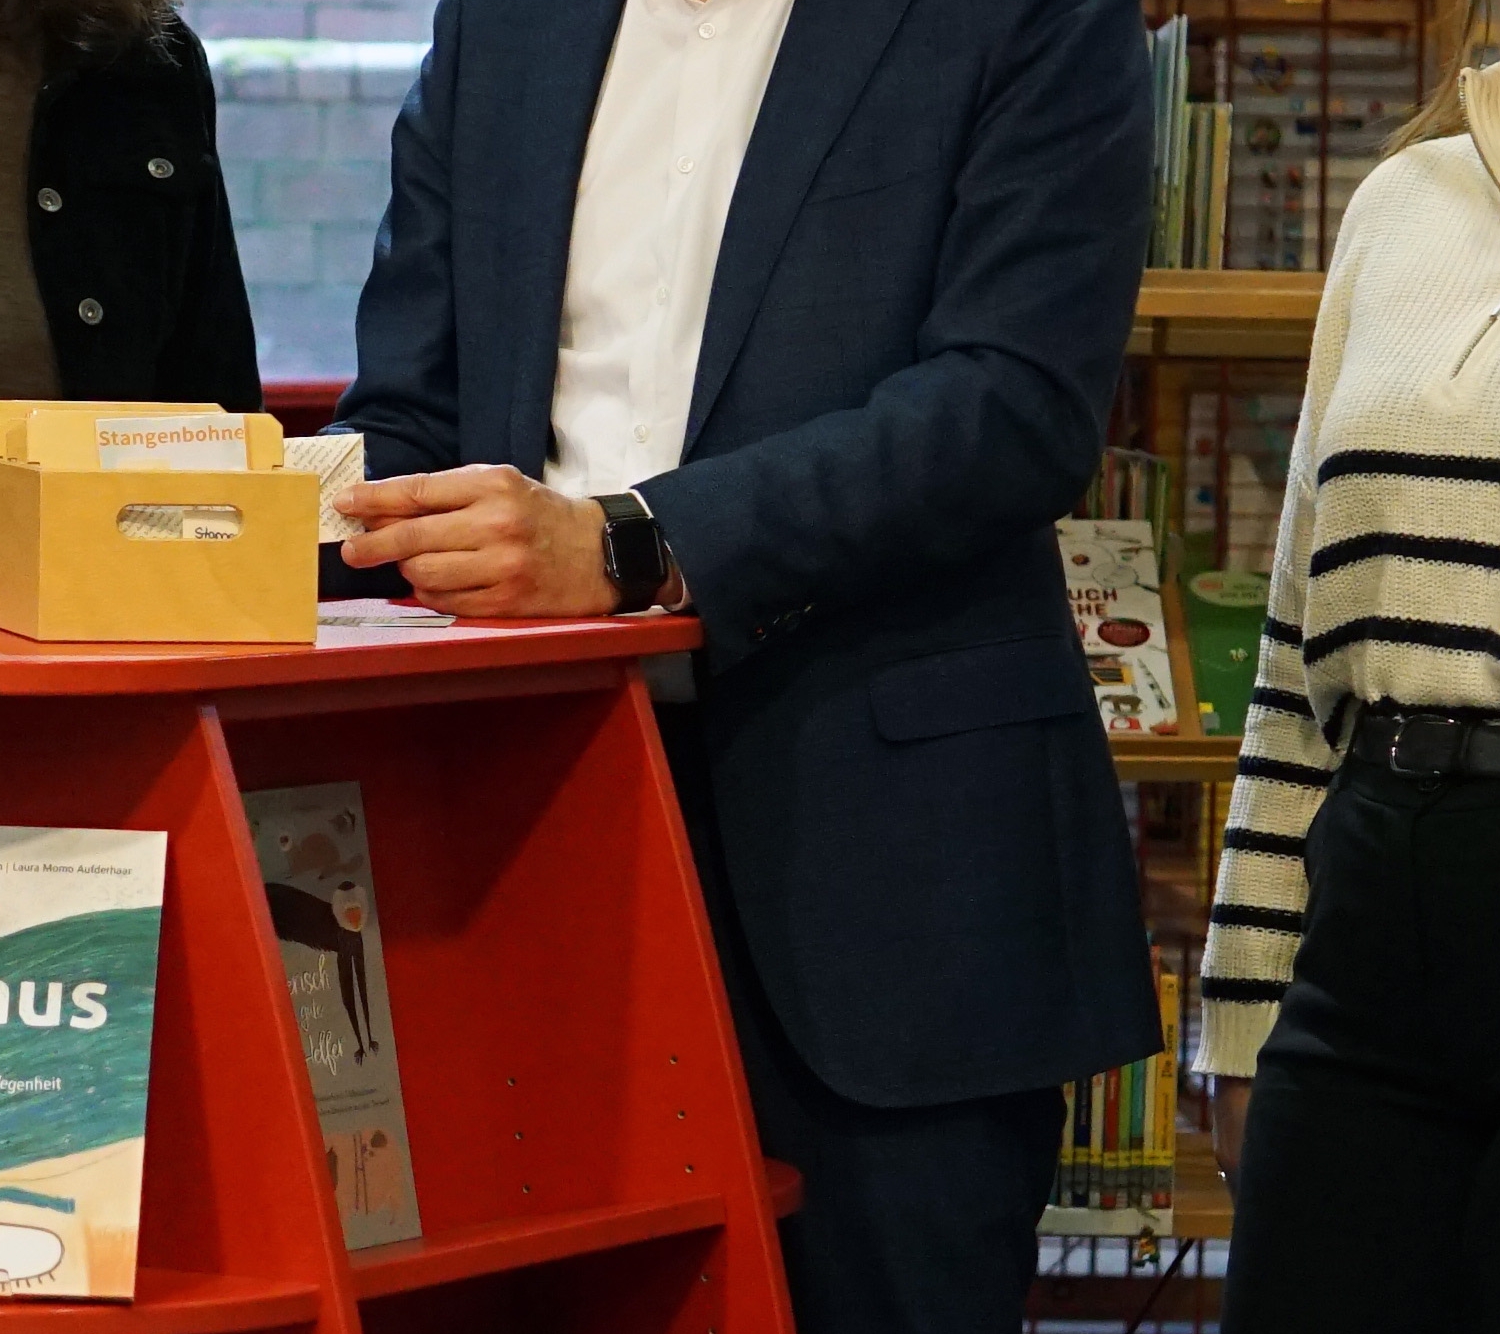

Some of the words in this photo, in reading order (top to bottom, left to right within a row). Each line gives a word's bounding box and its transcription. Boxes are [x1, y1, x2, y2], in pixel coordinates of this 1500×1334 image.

[12, 861, 40, 874] Laura
[42, 862, 75, 875] Momo
[76, 863, 134, 877] Aufderhaar
